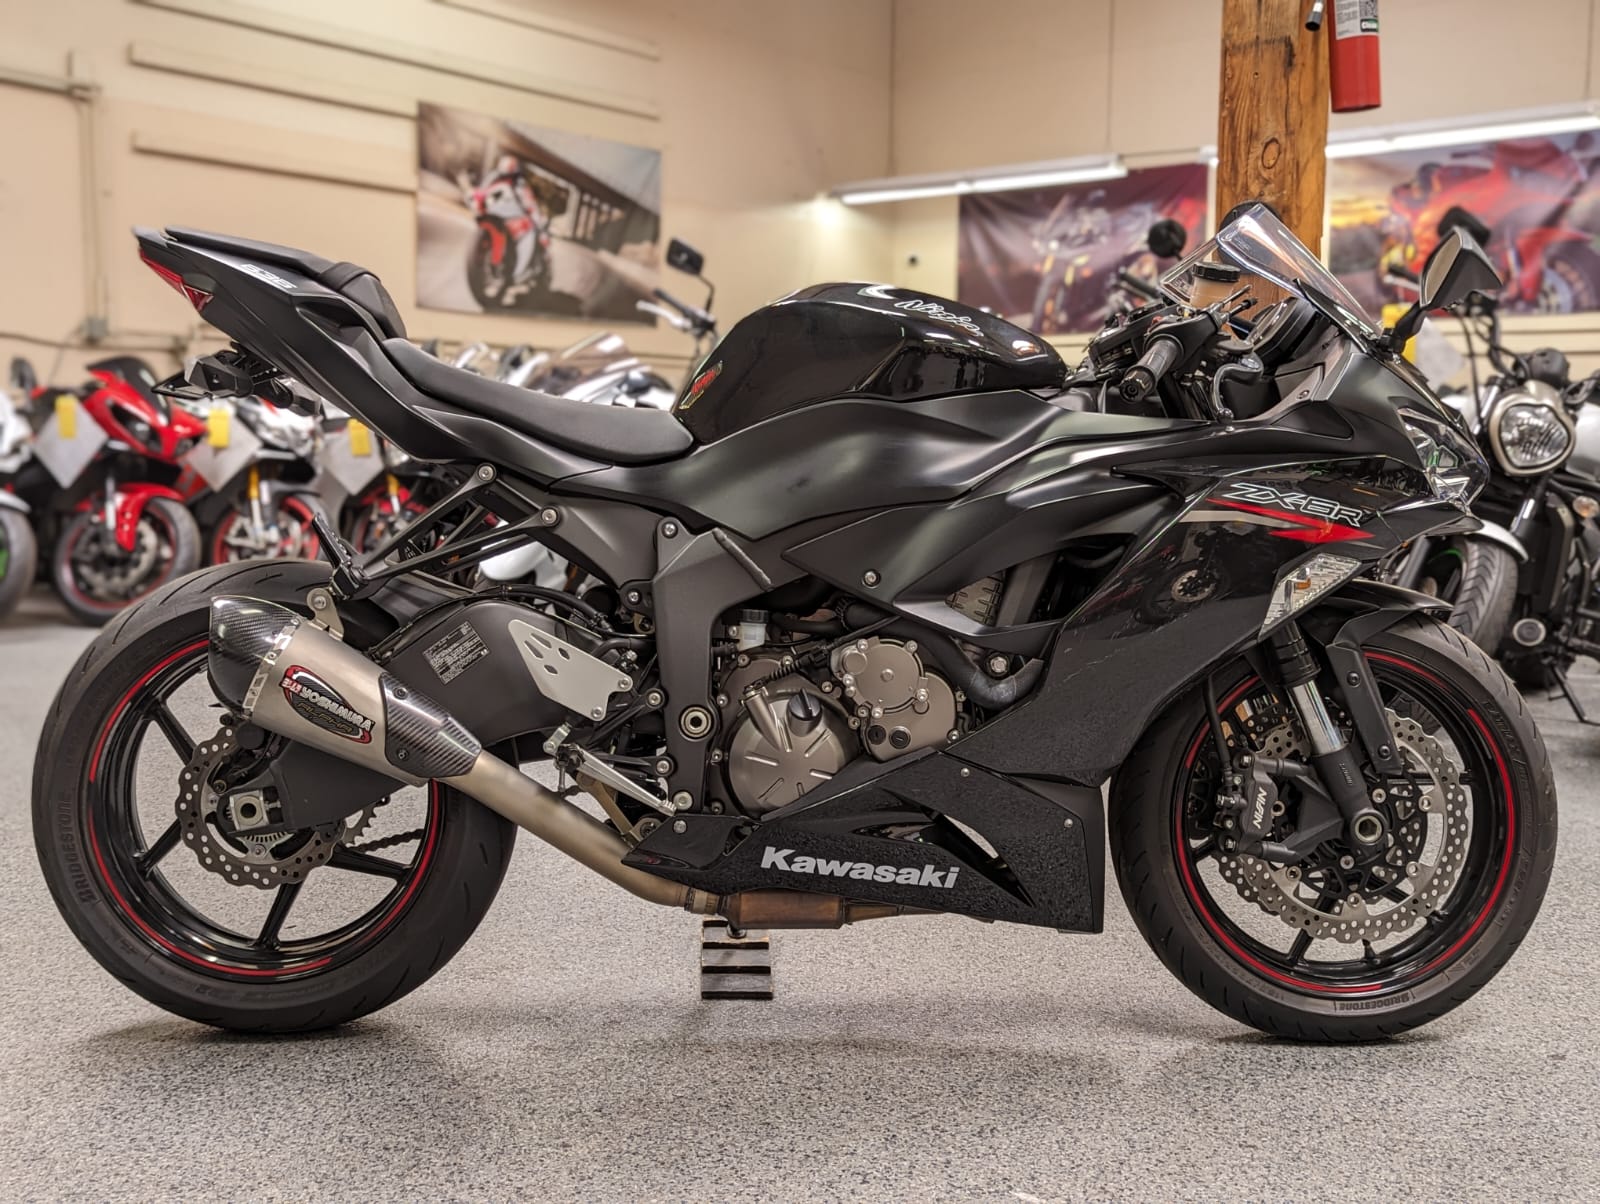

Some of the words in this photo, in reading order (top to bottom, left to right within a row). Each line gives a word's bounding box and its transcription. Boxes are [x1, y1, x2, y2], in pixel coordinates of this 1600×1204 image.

[893, 299, 984, 337] Ninja
[1221, 482, 1364, 527] ZX-6R
[300, 686, 372, 731] YOSHIMURA
[760, 845, 960, 889] Kawasaki
[1339, 992, 1410, 1011] BRIDGESTONE
